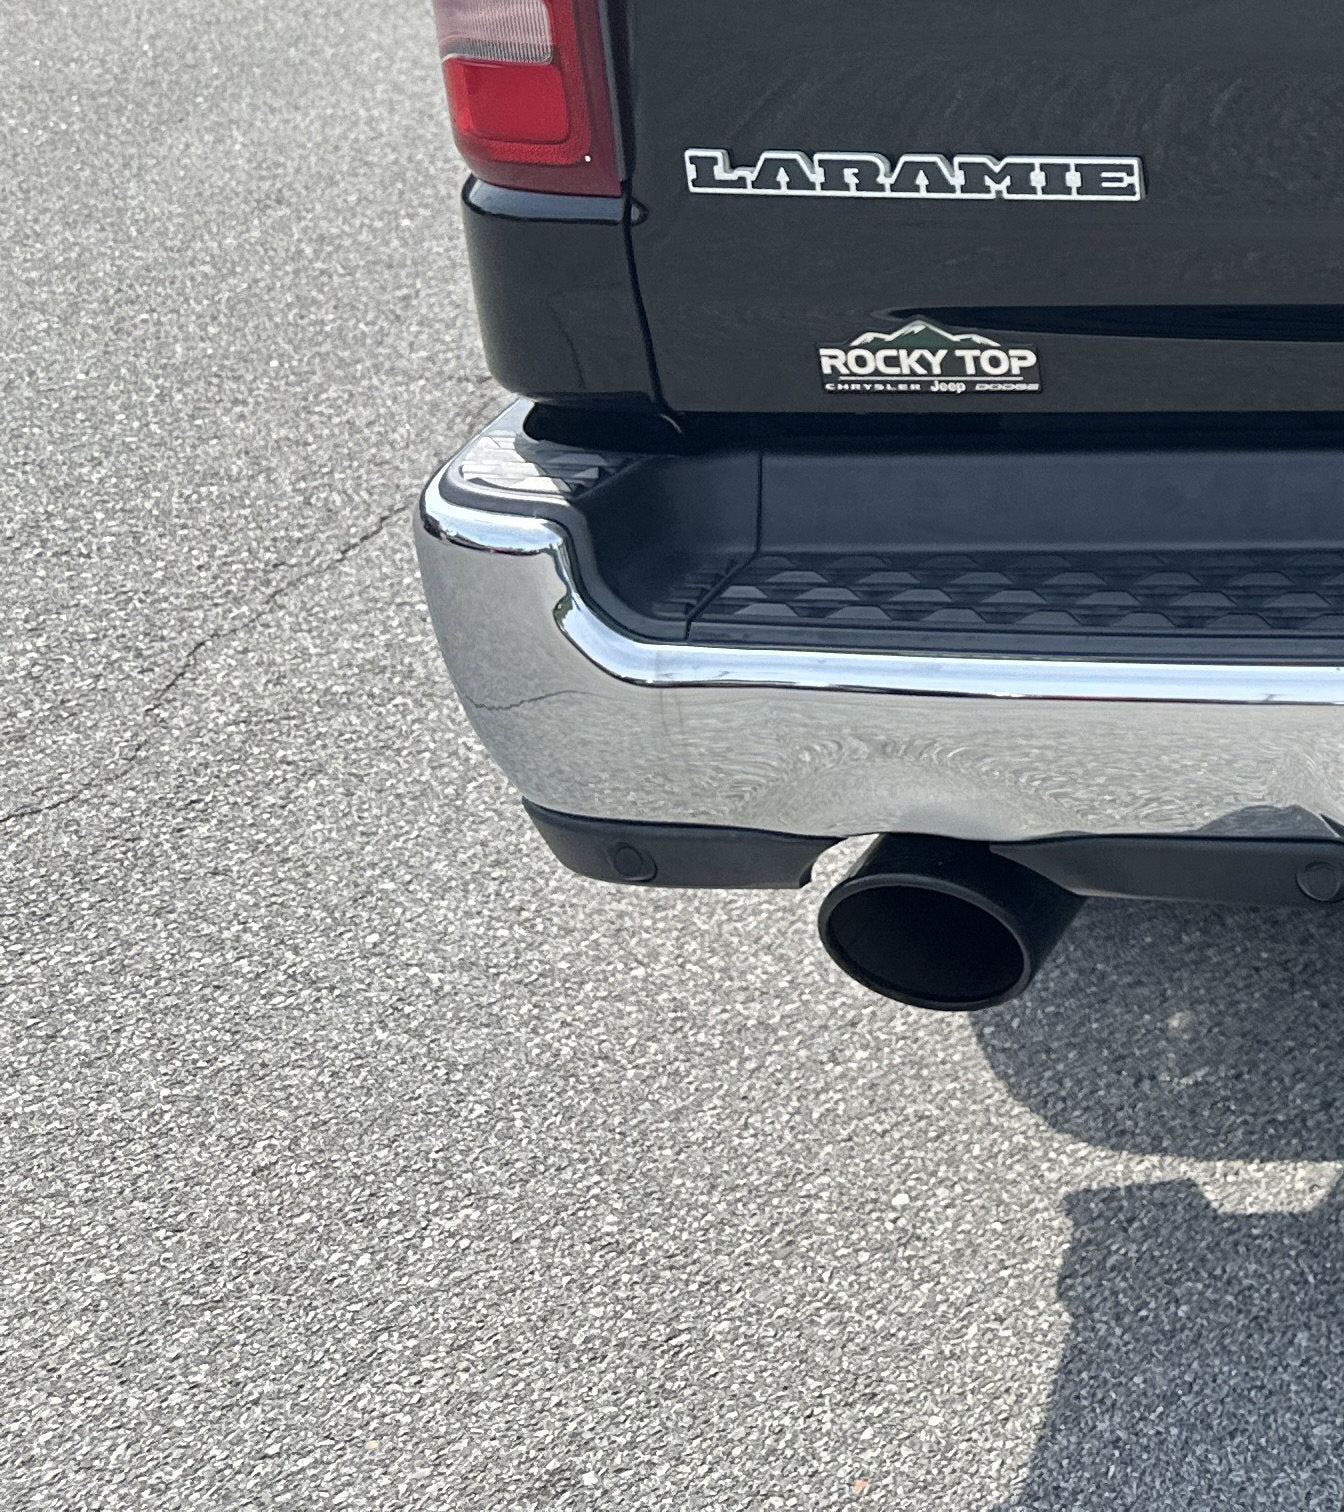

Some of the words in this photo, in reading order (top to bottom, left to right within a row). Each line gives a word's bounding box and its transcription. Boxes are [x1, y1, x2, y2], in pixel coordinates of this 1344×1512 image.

[684, 149, 1144, 202] LARAMIE
[819, 348, 948, 376] ROCKY
[954, 348, 1037, 375] TOP
[930, 380, 966, 394] Jeep
